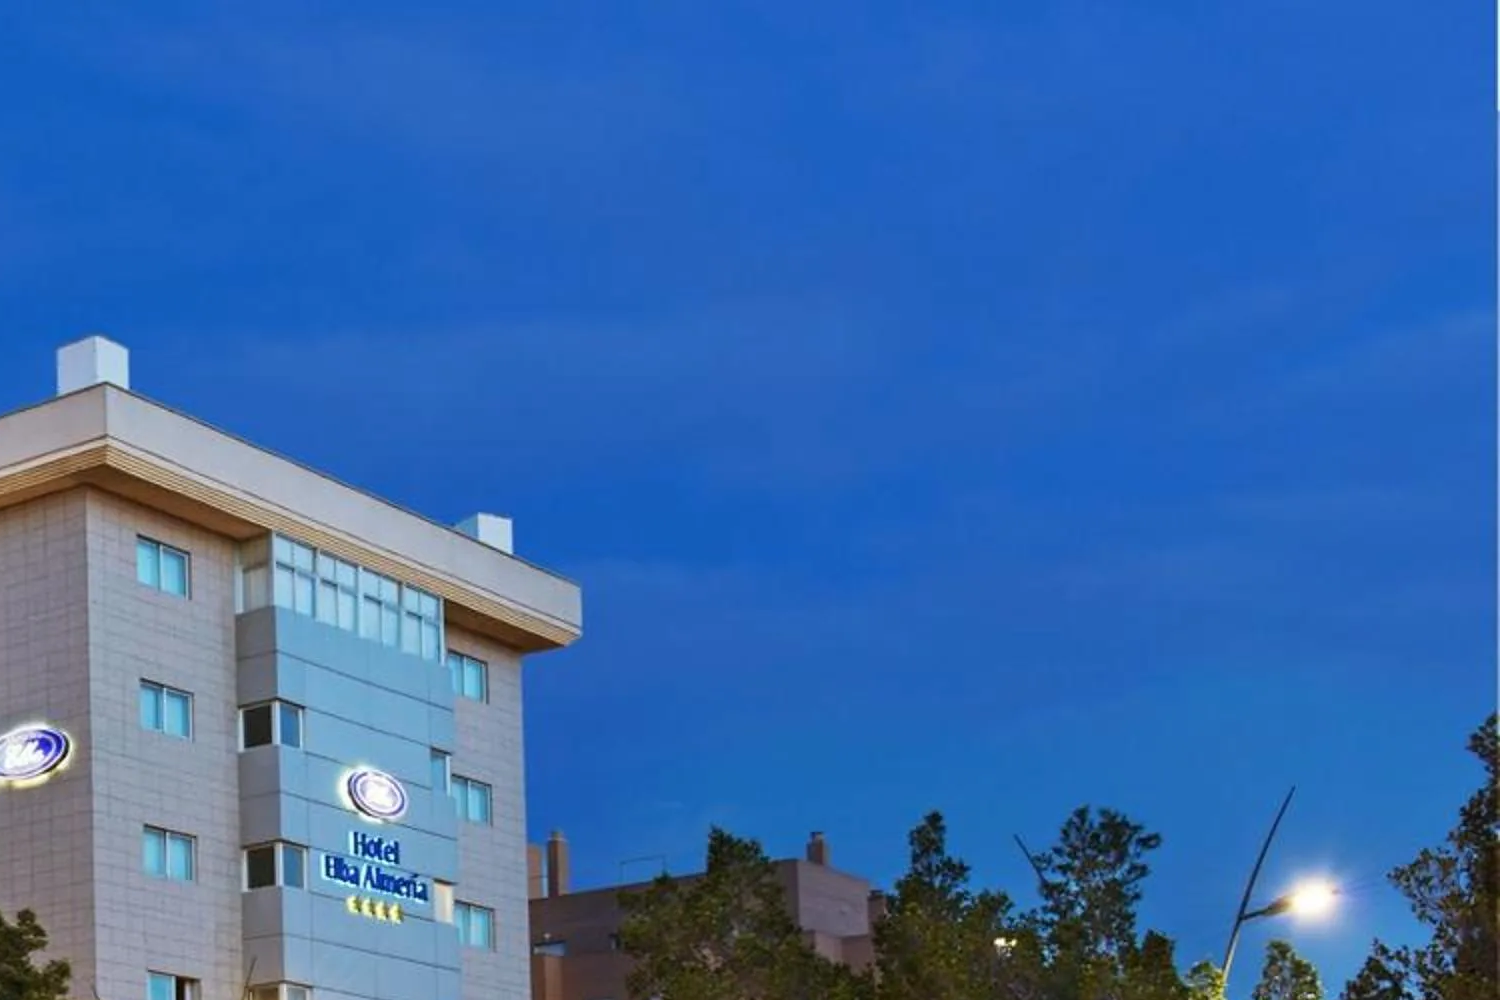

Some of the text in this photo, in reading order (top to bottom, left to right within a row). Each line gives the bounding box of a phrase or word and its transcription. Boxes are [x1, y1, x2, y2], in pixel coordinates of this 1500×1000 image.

[349, 831, 400, 865] Hotel
[321, 853, 429, 903] Elba Almería
